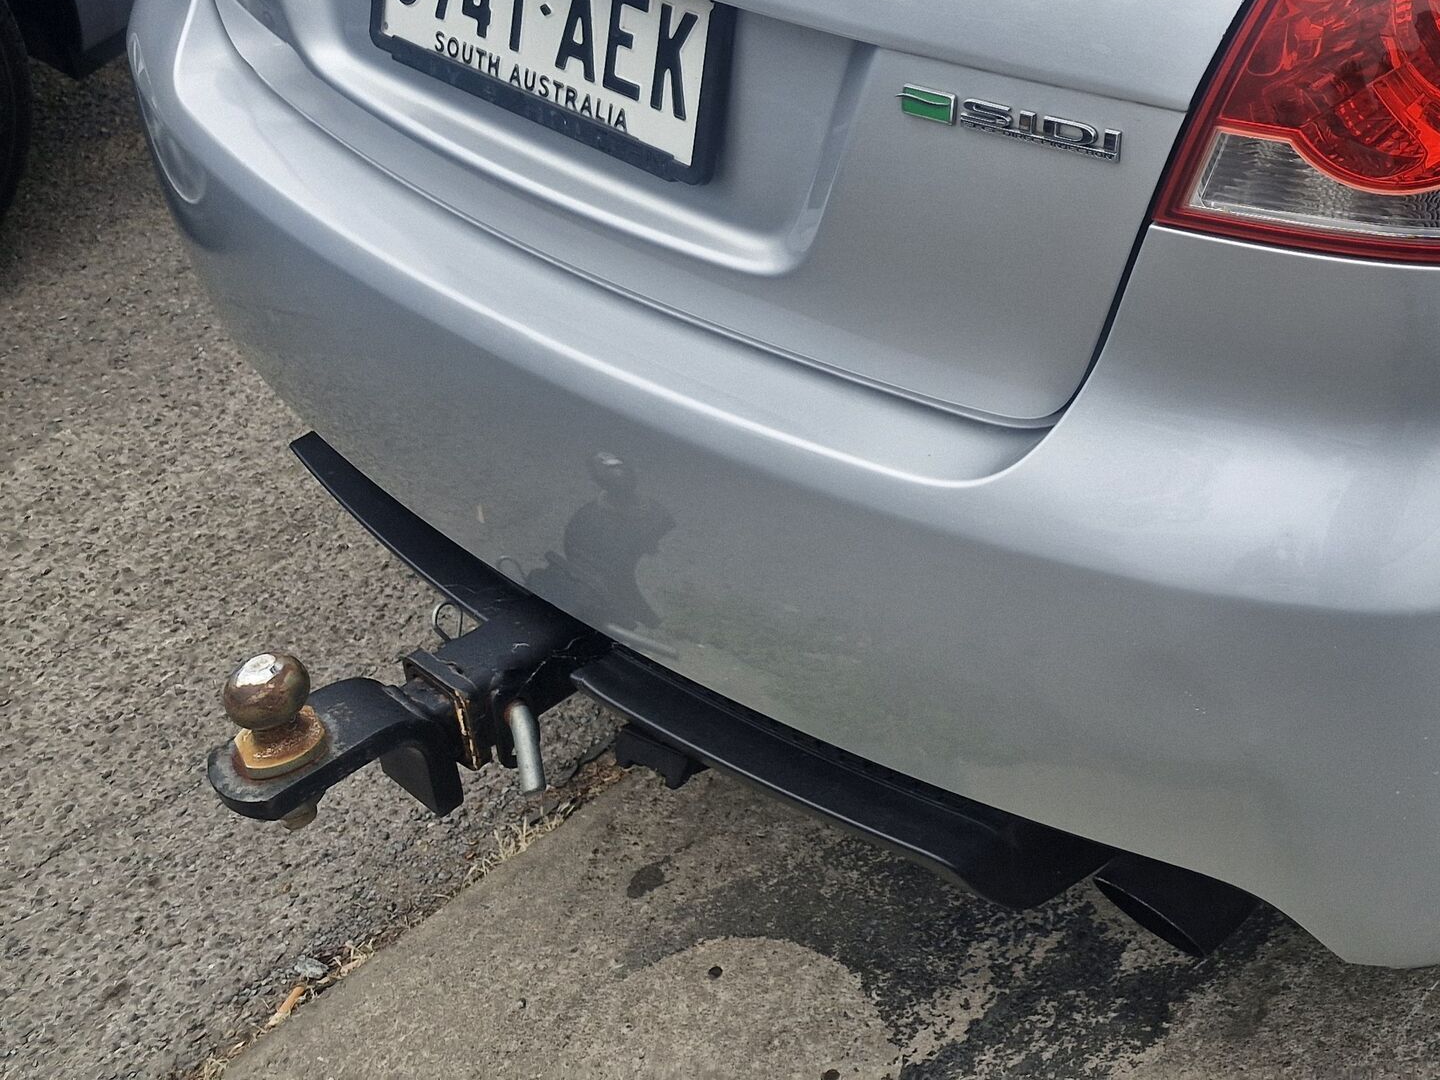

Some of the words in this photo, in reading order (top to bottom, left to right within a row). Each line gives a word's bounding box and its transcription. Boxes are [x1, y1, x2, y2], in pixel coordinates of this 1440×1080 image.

[435, 31, 501, 78] SOUTH
[509, 64, 629, 134] AUSTRALIA
[960, 98, 1122, 160] SIDI
